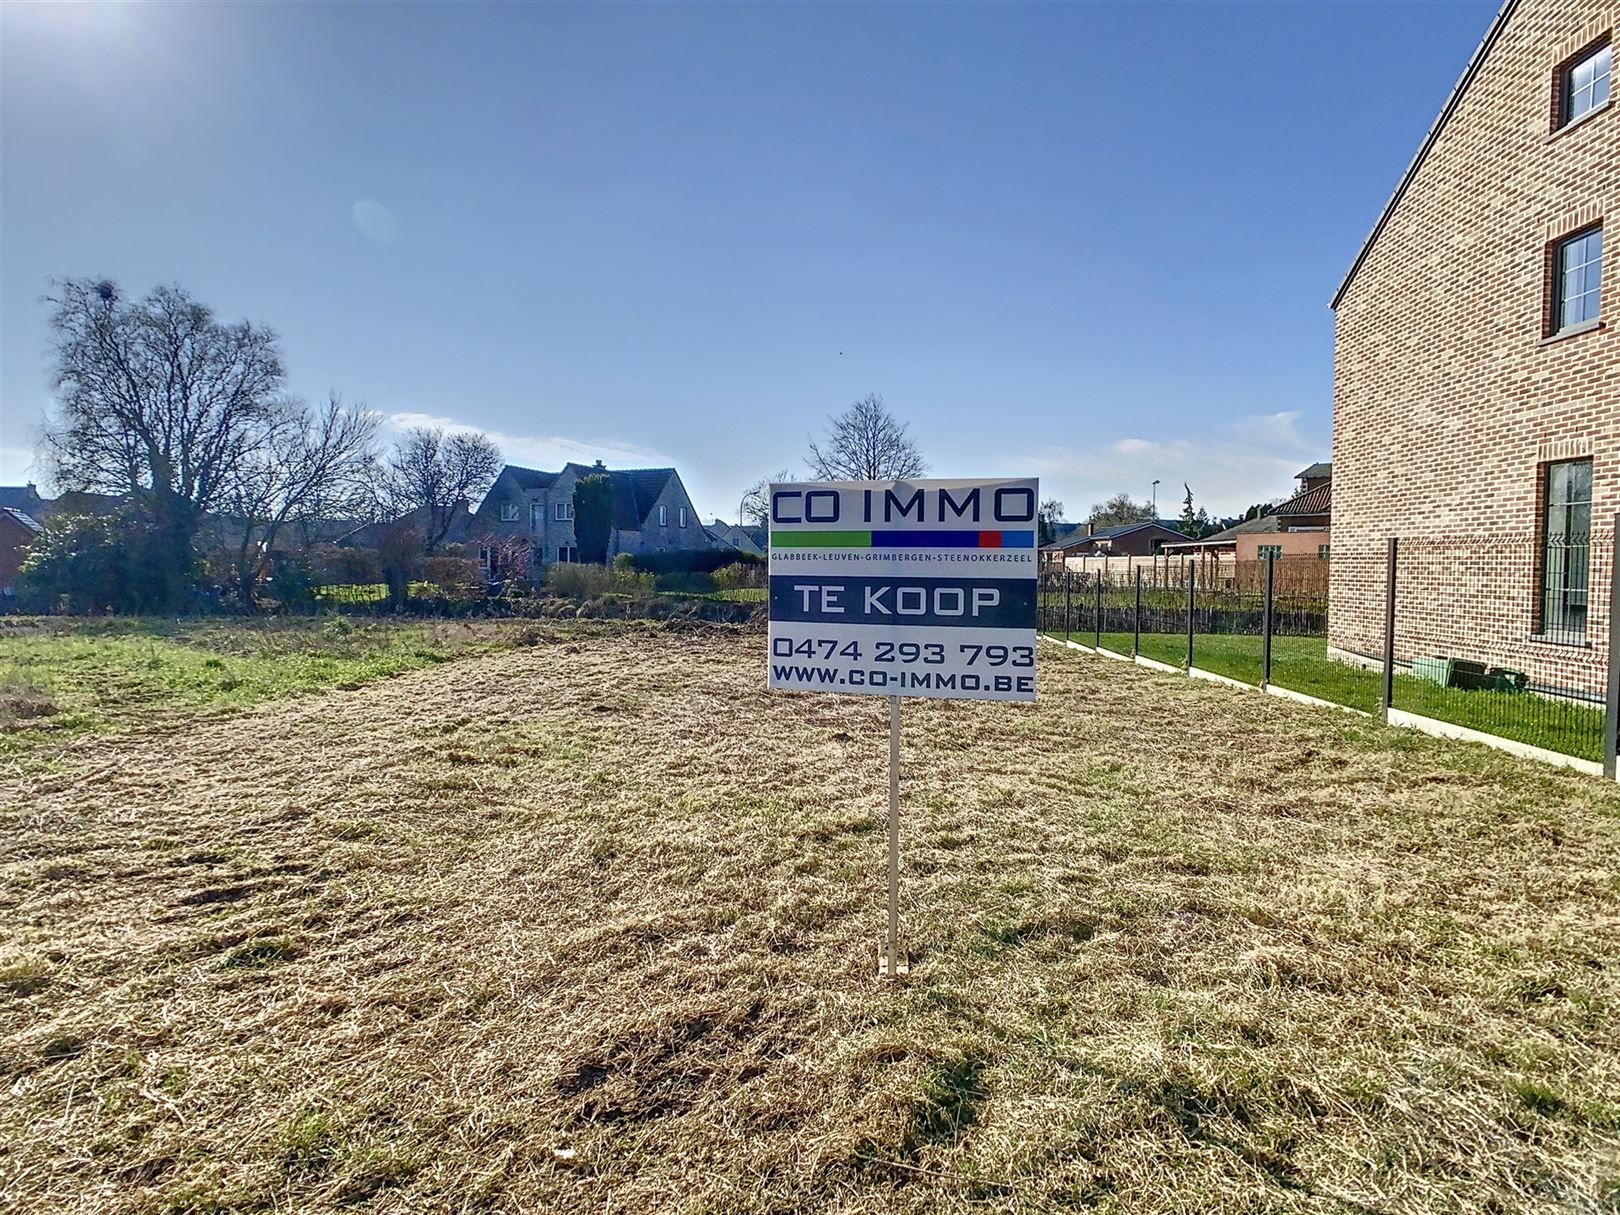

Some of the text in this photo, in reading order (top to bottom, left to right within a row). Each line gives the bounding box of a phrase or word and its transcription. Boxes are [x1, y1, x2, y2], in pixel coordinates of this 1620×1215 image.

[772, 488, 1034, 523] CO IMMO
[771, 553, 1032, 563] GLABBEEK-LEUVEN-GRIMBERGEN-STEENOKKERZEEL
[794, 585, 1000, 617] TE KOOP
[773, 637, 1034, 667] 0474 293 793
[773, 665, 1034, 693] WWW.CO-IMMO.BE
